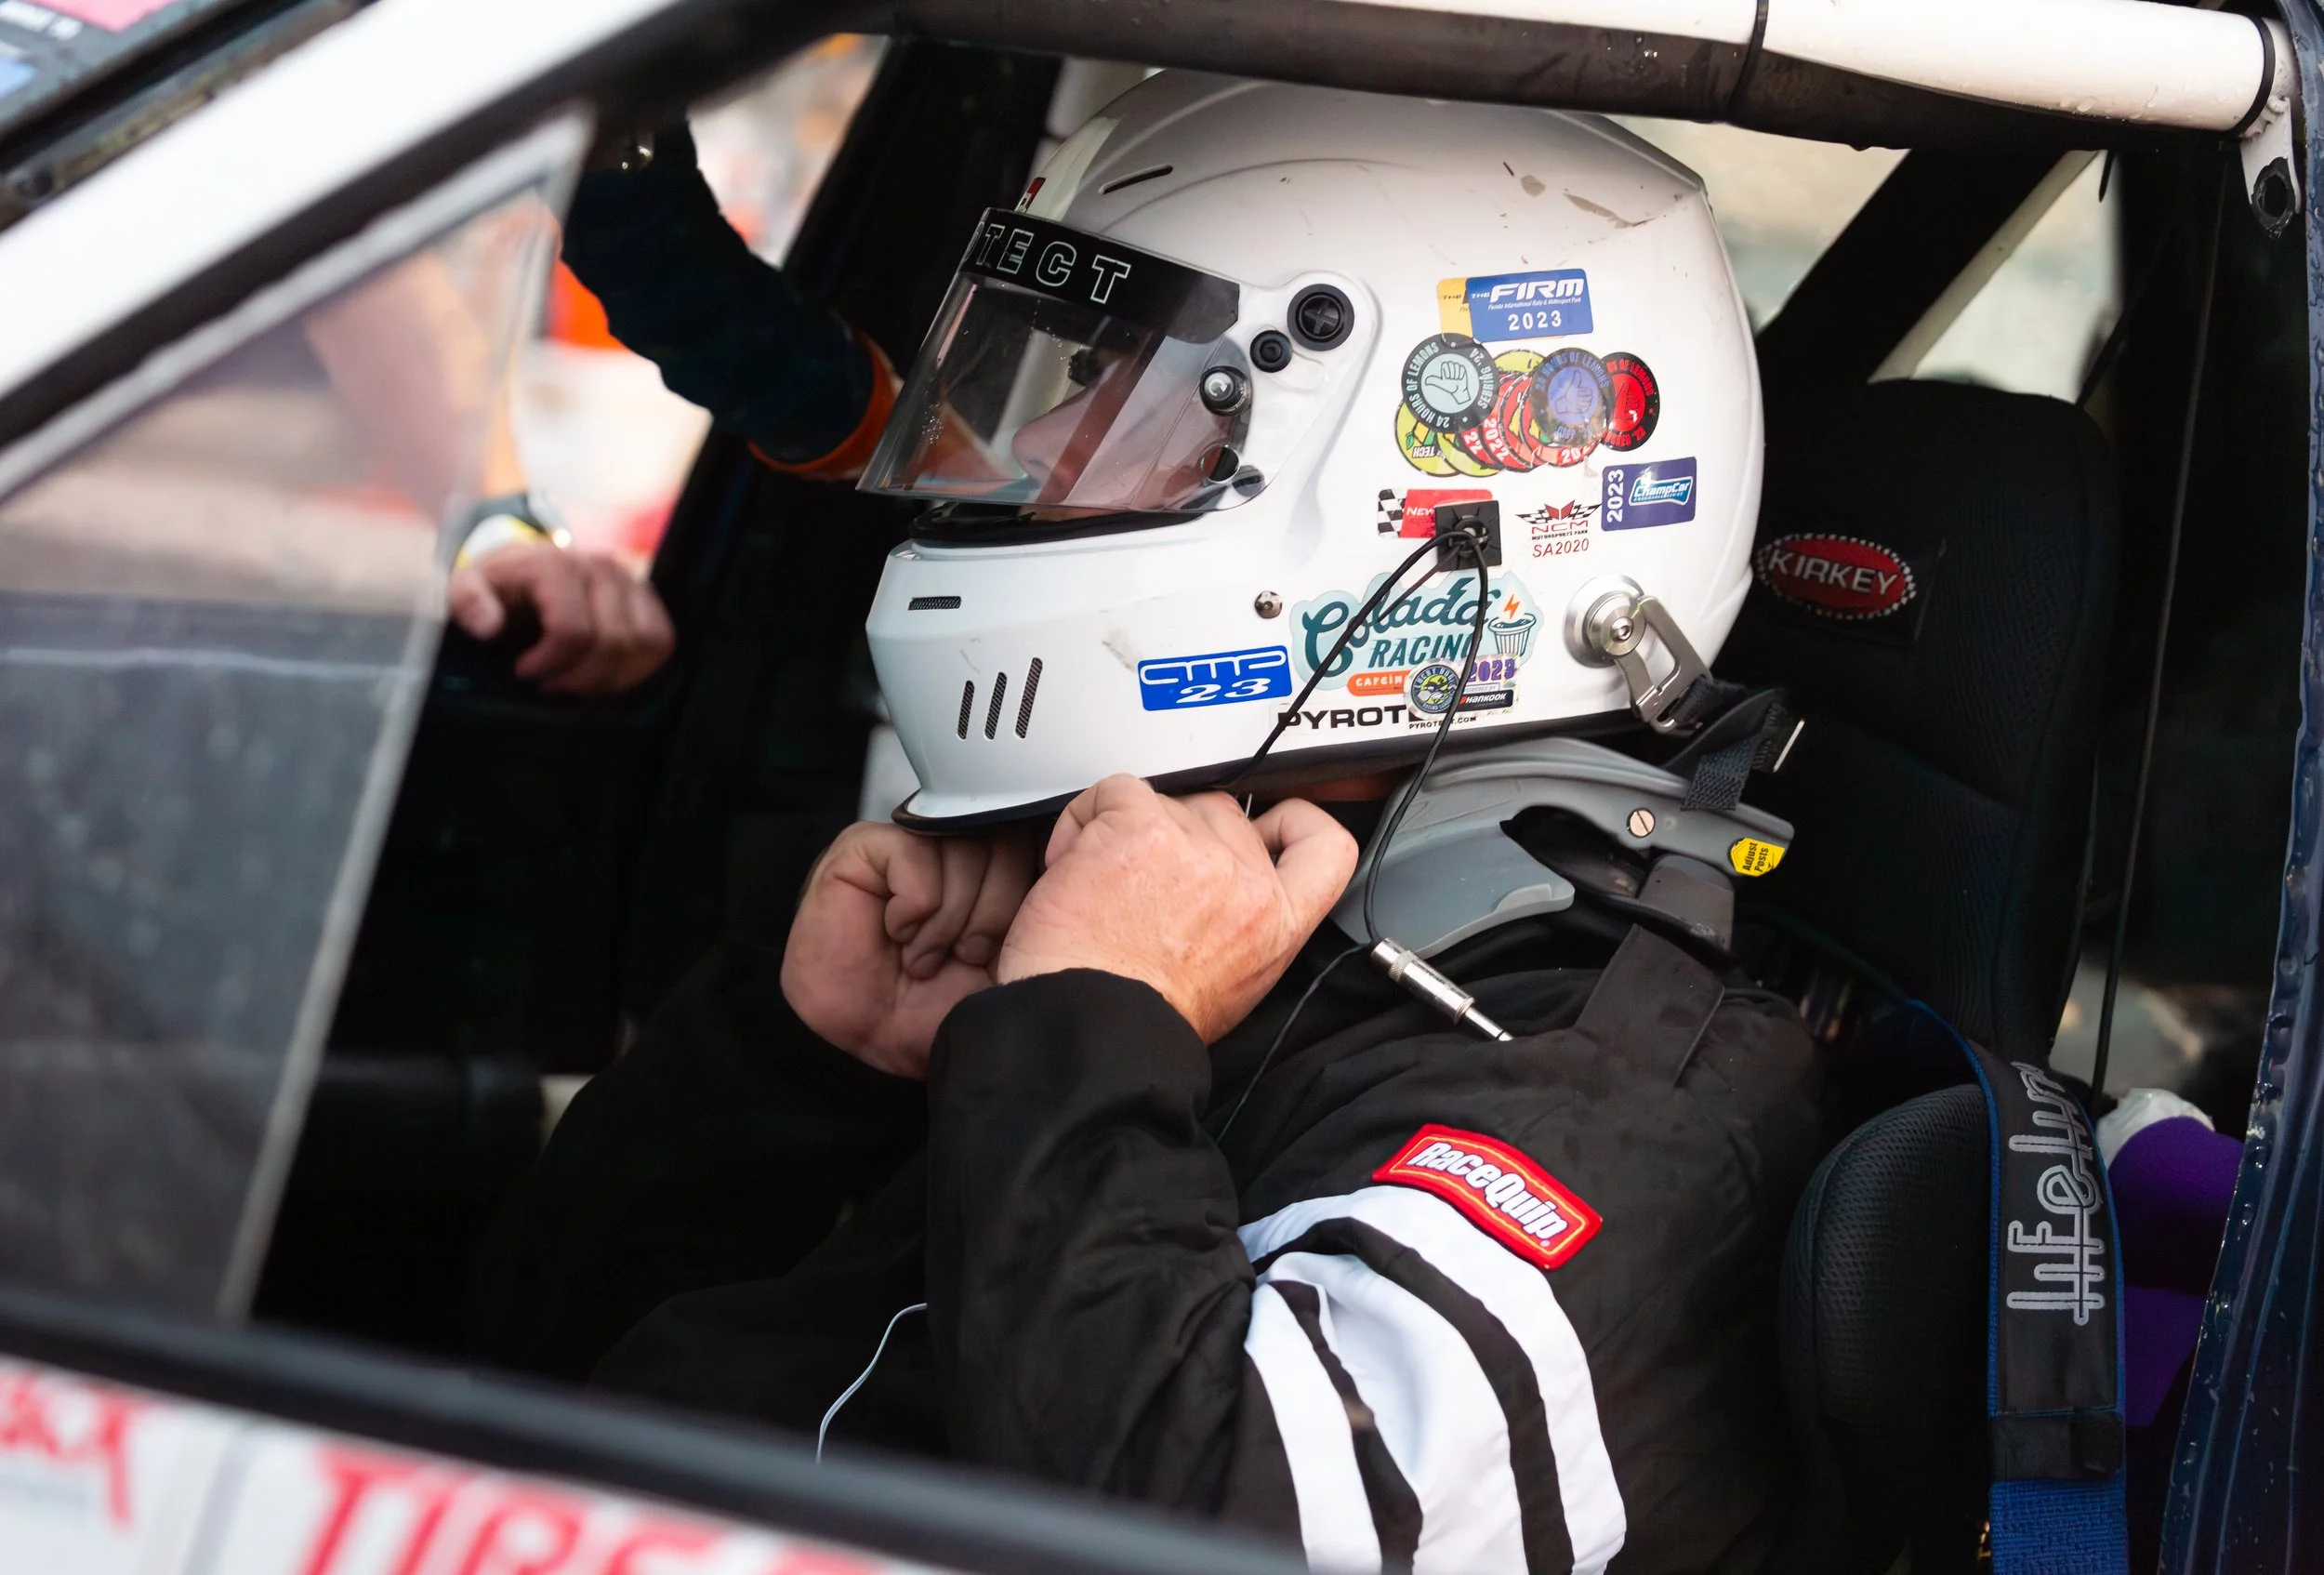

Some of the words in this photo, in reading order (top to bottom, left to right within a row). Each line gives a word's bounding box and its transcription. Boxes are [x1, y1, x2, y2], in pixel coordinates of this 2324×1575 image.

[964, 221, 1131, 304] TECT
[1489, 278, 1585, 304] FIRM
[1507, 310, 1563, 331] 2023
[1409, 342, 1440, 377] LEMONS
[1406, 378, 1418, 391] OF
[1477, 365, 1495, 410] SEBRING
[1409, 394, 1436, 423] HOURS
[1436, 416, 1450, 429] 24
[1412, 446, 1435, 458] TECH
[1606, 469, 1624, 523] 2023
[1532, 520, 1589, 534] NCM
[1532, 537, 1589, 558] SA2020
[1768, 549, 1898, 596] KIRKEY
[1468, 658, 1516, 682] 2023
[1175, 678, 1272, 704] 23
[1278, 705, 1425, 730] PYROT
[1742, 841, 1758, 871] Adjust
[1754, 847, 1769, 873] Posts
[1406, 1142, 1569, 1240] RaceQuip
